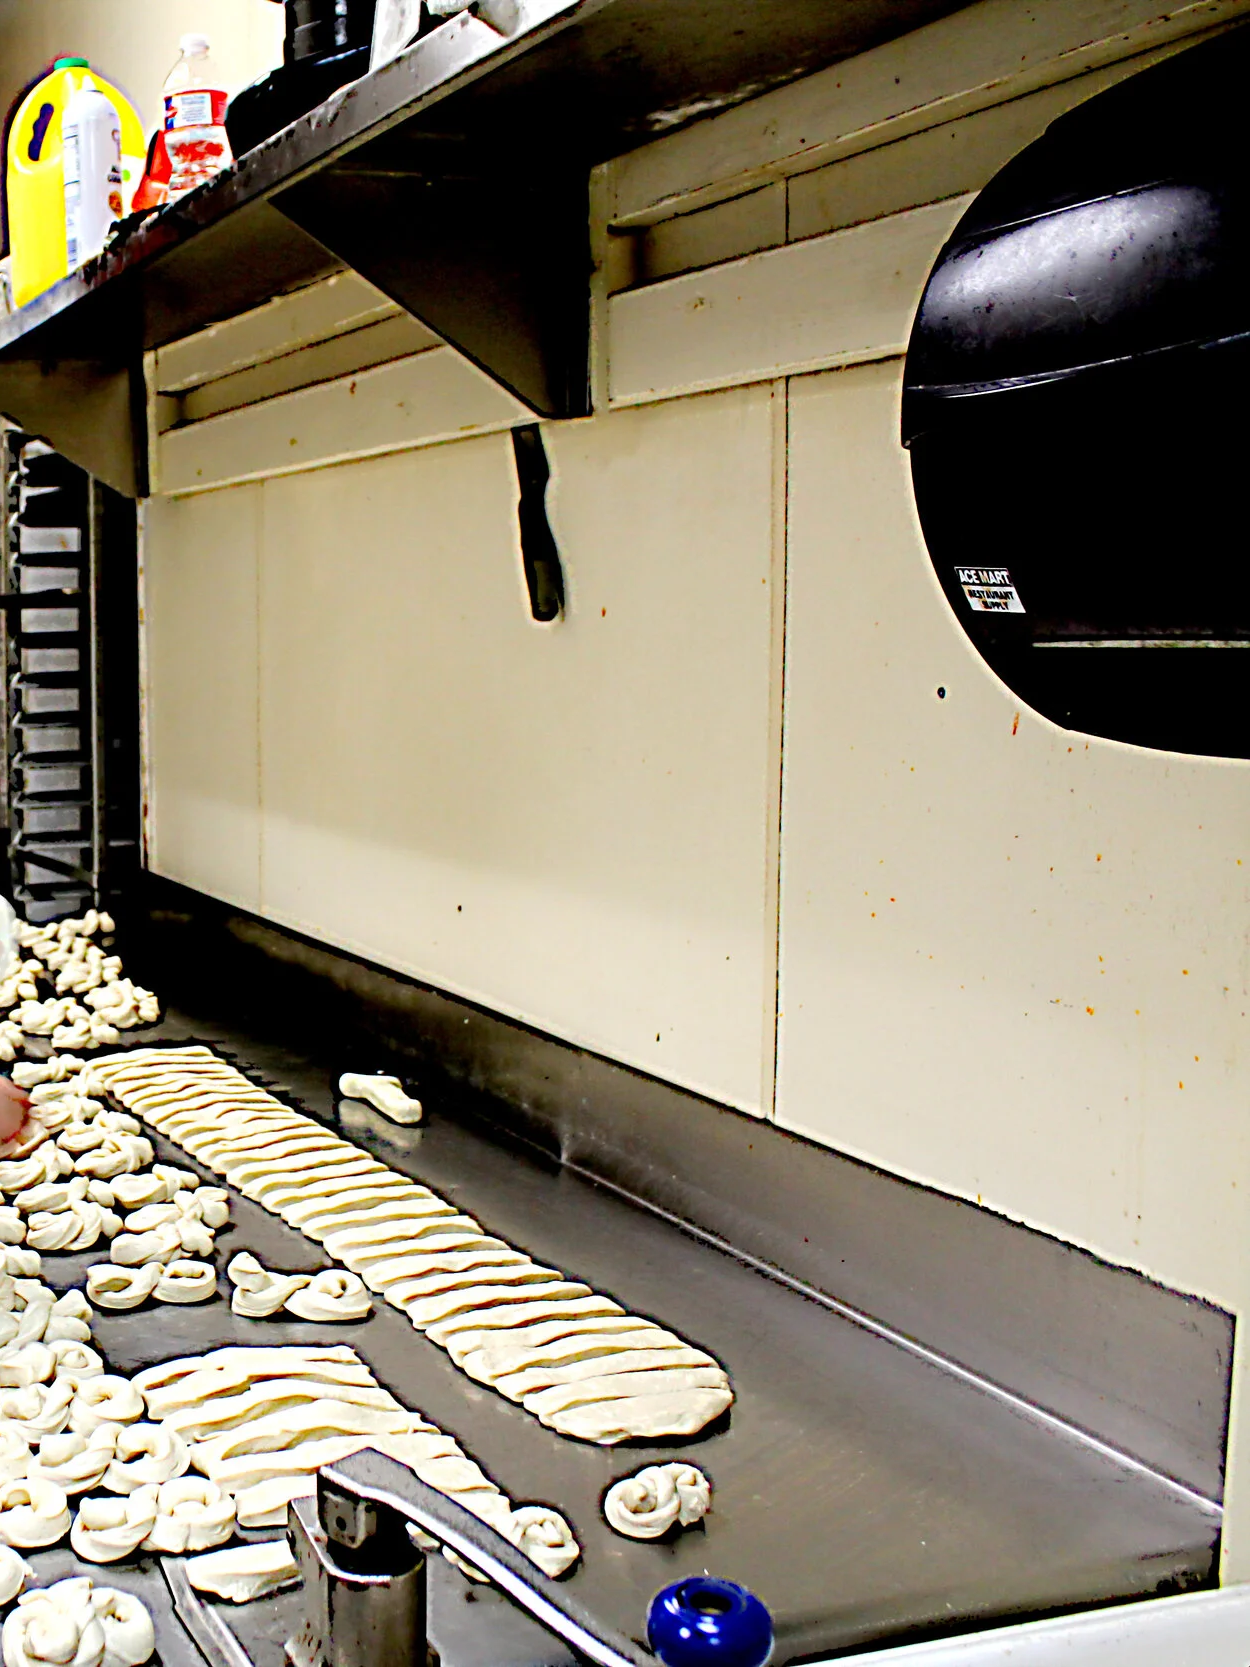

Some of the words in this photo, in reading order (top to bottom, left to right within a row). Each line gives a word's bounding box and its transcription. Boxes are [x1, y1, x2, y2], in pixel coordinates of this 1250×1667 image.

[958, 569, 980, 584] ACE
[978, 570, 1010, 585] MART
[967, 589, 1014, 600] RESTAURANT
[981, 600, 1009, 611] SUPPLY
